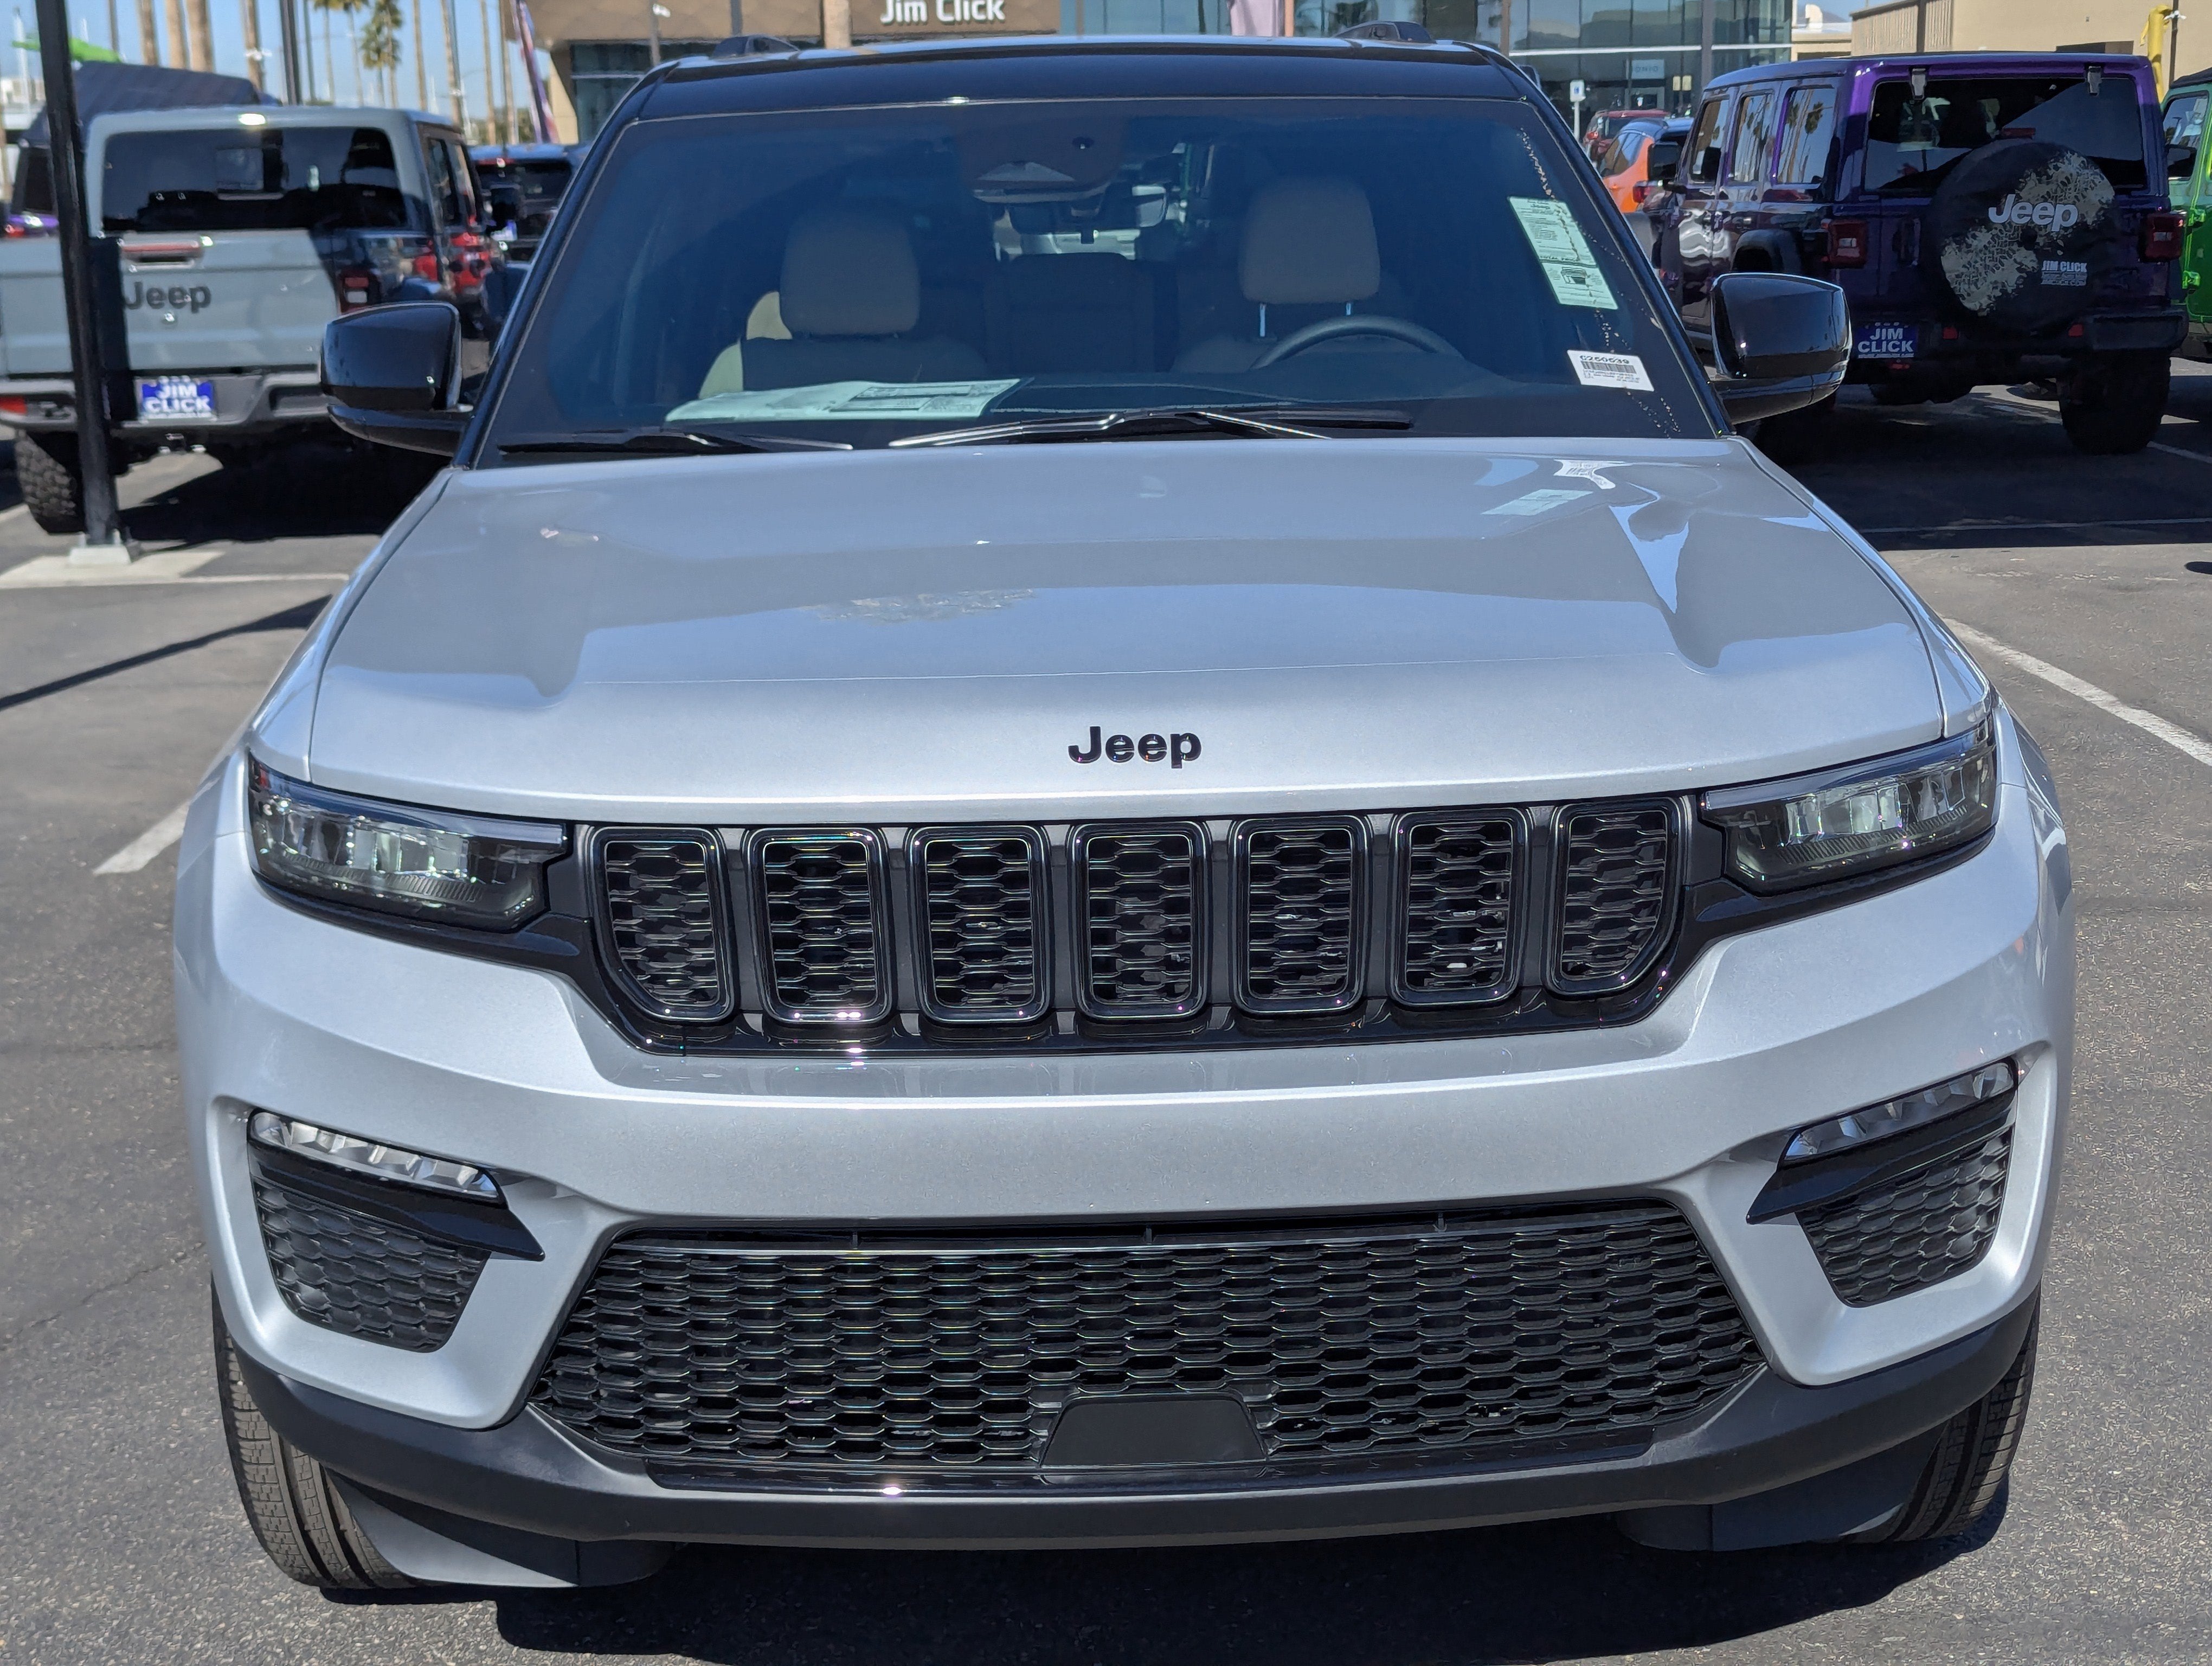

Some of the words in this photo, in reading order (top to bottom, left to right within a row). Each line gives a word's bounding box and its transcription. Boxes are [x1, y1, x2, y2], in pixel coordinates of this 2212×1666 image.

[879, 0, 928, 23] Jim
[936, 0, 1006, 22] Click
[1988, 194, 2078, 232] Jeep
[2041, 260, 2059, 271] JIM
[2060, 261, 2087, 272] CLICK
[125, 281, 212, 313] Jeep
[1869, 328, 1903, 340] JIM
[1857, 341, 1914, 353] CLICK
[156, 385, 197, 399] JIM
[143, 396, 212, 413] CLICK
[1068, 726, 1202, 768] Jeep
